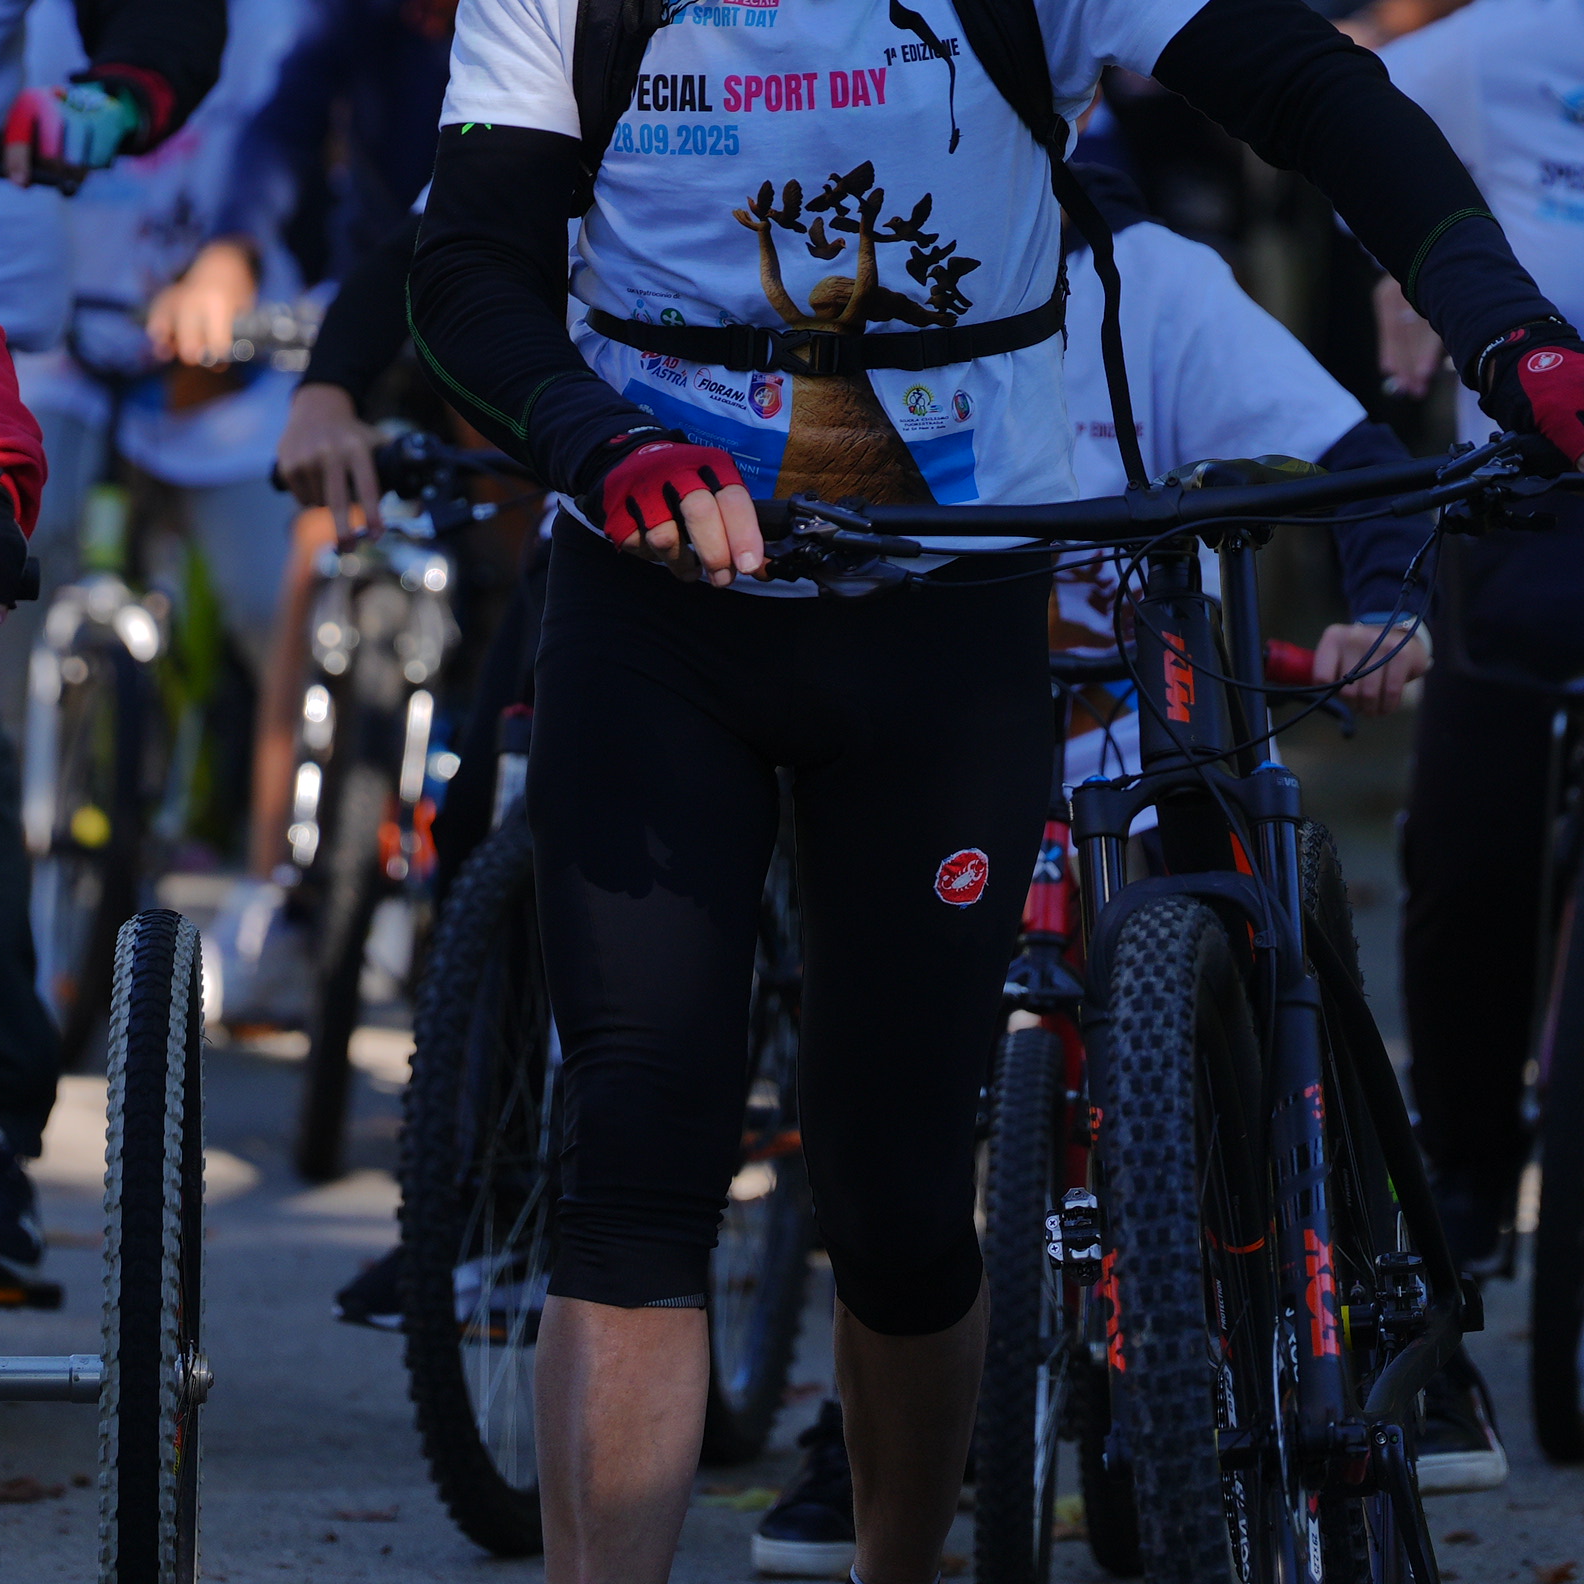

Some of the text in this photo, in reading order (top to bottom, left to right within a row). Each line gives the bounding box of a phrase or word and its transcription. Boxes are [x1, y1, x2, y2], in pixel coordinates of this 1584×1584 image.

[693, 6, 778, 28] SPORT DAY
[634, 67, 887, 112] ECIAL SPORT DAY
[613, 122, 740, 156] 28.09.2025
[652, 367, 687, 388] ASTRA
[662, 355, 680, 369] AD
[698, 378, 746, 402] FIORANI
[1161, 630, 1196, 724] KTM
[1219, 1278, 1229, 1332] PROTECTION
[1304, 1228, 1341, 1356] FOX
